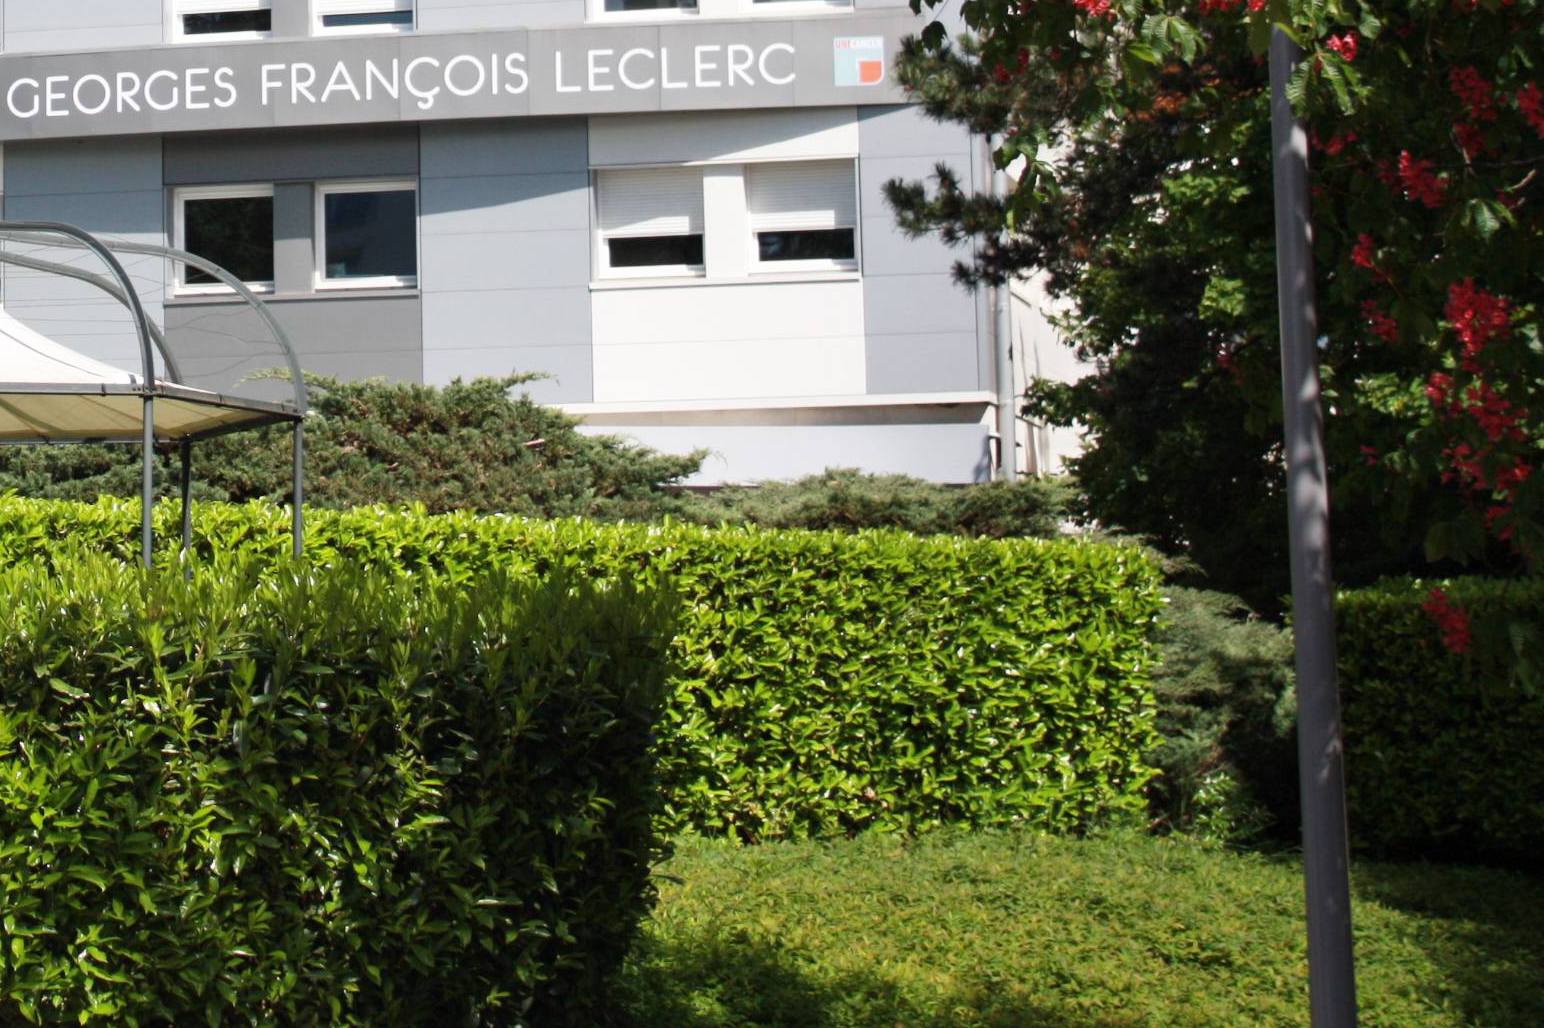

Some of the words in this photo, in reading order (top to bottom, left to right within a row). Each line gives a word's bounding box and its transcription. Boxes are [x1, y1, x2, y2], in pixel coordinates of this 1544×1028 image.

[6, 66, 238, 119] GEORGES
[260, 51, 529, 110] FRANÇOIS
[554, 42, 797, 93] LECLERC
